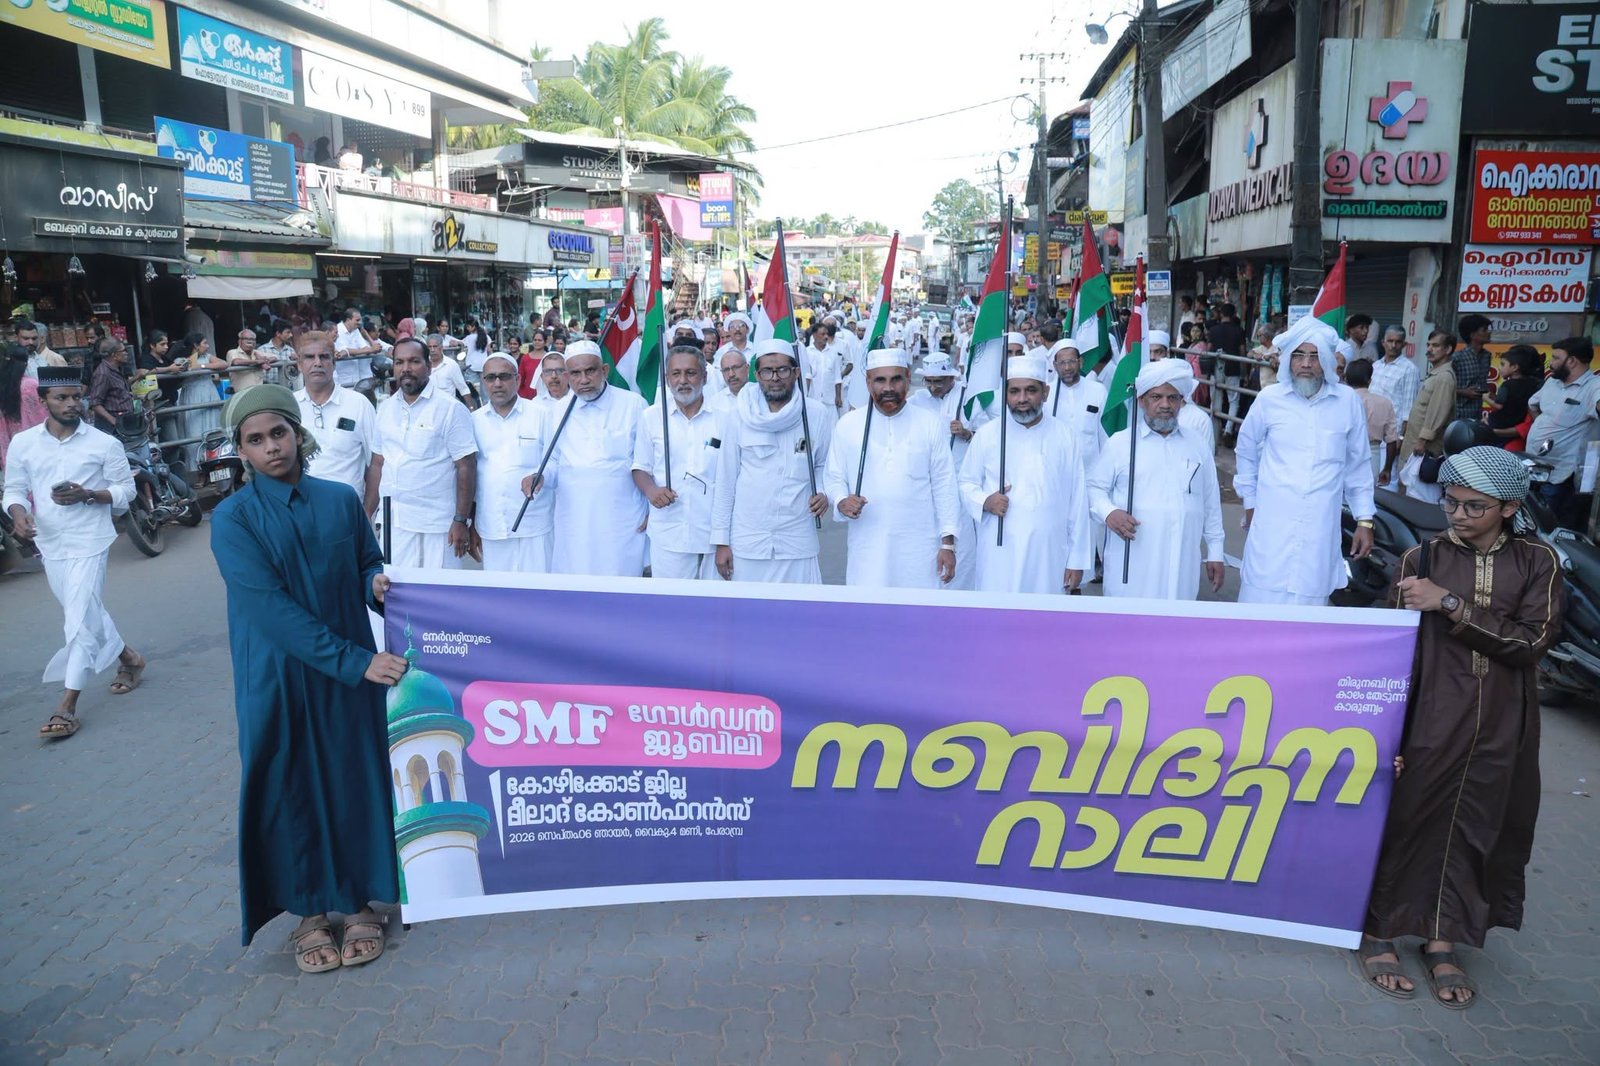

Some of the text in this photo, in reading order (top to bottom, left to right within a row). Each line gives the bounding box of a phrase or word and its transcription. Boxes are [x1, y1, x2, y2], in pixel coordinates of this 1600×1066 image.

[1324, 150, 1450, 195] ഉദയ
[60, 182, 158, 213] വാസീസ്
[1238, 161, 1294, 215] MEDICAL
[706, 202, 727, 212] boon
[1327, 200, 1447, 217] മെഡിക്കൽസ്
[1488, 194, 1592, 213] ഓൺലൈൻ
[1069, 210, 1105, 222] dialgue
[1487, 212, 1588, 229] സേവനങ്ങൾ
[44, 222, 87, 236] ബേക്കറി
[90, 225, 124, 237] കോഫി
[125, 228, 133, 237] &
[548, 229, 595, 253] GOODWILL
[1465, 247, 1592, 267] ഐറിസ്
[1460, 281, 1586, 309] കണ്ണടകൾ
[422, 630, 492, 646] നേർവഴിയുടെ
[422, 643, 468, 657] നാൾവഴി
[1335, 690, 1365, 700] കാലം
[483, 699, 614, 745] SMF
[627, 701, 775, 733] ഗോൾഡൻ
[643, 730, 763, 760] ജൂബിലി
[791, 675, 1379, 806] നബിദിന
[506, 768, 688, 800] കോഴിക്കോട് ജില്ല
[507, 795, 754, 827] മീലാദ് കോൺഫറൻസ്
[508, 831, 536, 844] 2026
[679, 825, 703, 837] മണി,
[976, 767, 1291, 883] റാലി
